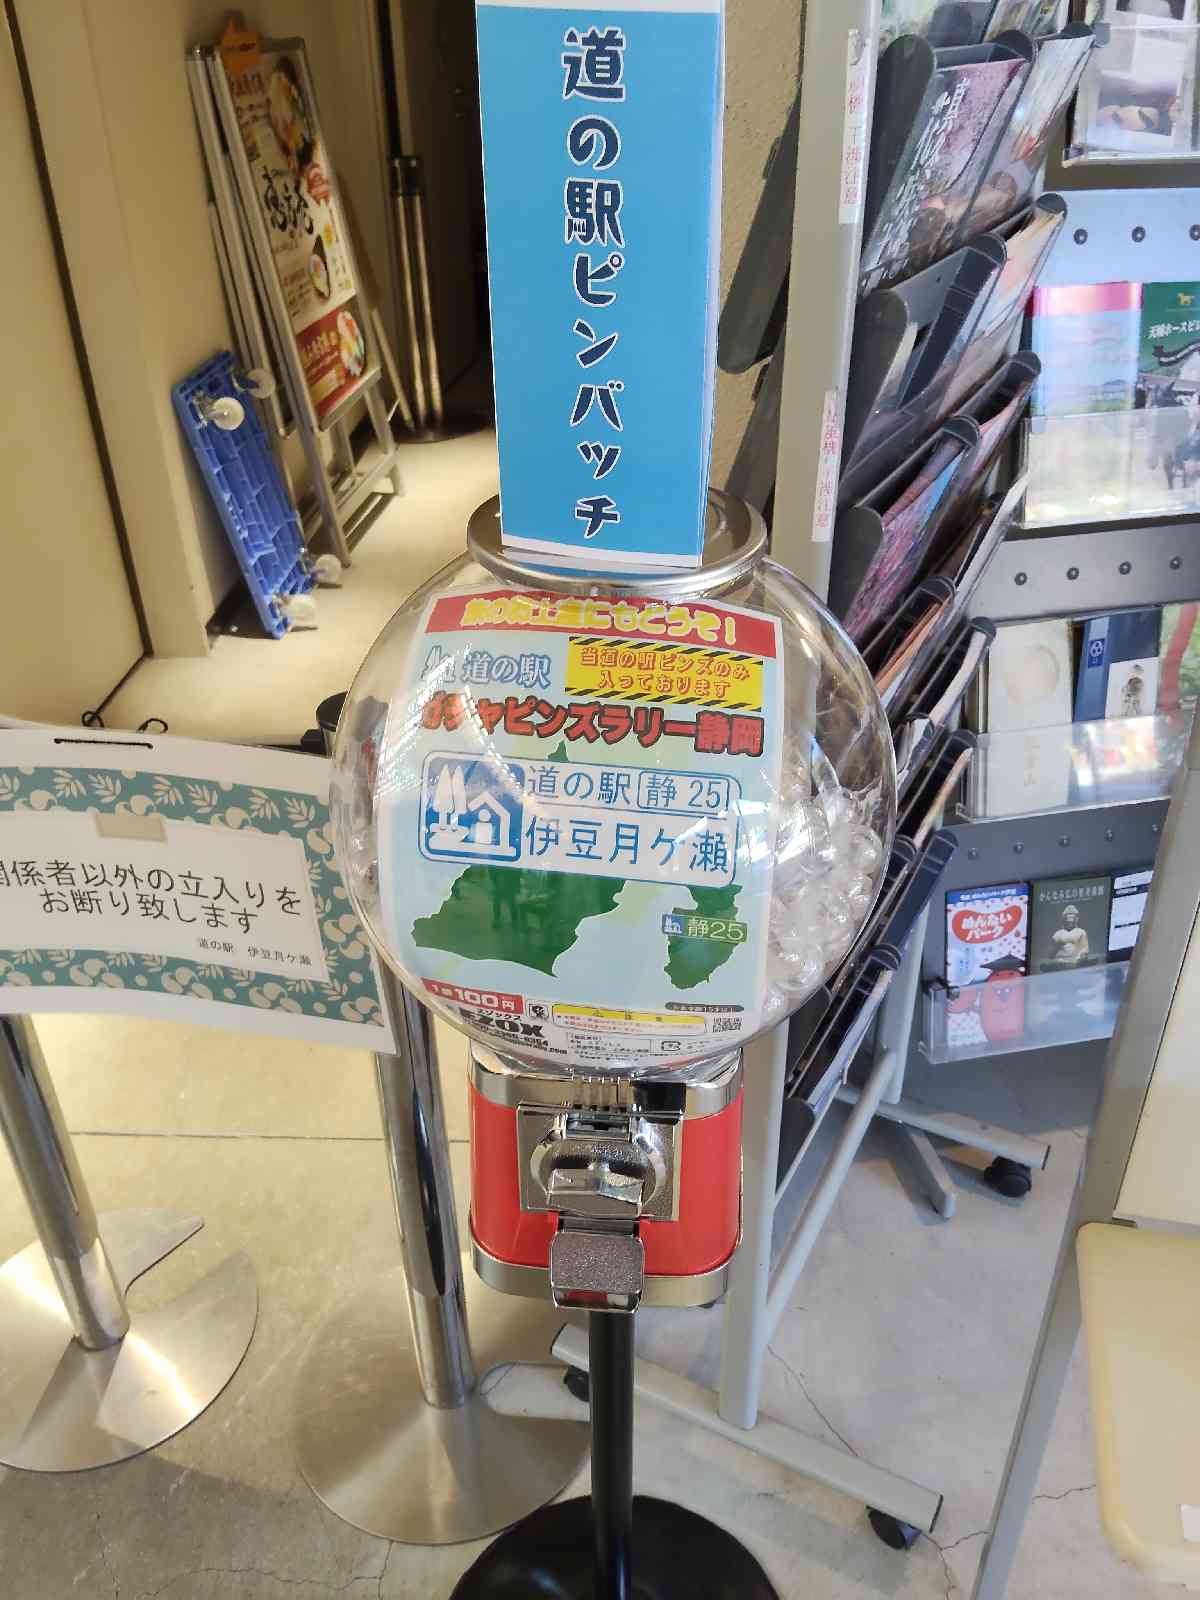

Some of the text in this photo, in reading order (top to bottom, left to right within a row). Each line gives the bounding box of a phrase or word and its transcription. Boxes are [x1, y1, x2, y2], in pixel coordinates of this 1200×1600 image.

[560, 27, 625, 538] 道の駅ピンバッチ
[462, 650, 551, 690] 道の駅
[581, 647, 750, 681] 当道の駅ピンズのみ
[599, 670, 731, 699] 入っております
[527, 765, 632, 806] 道の駅
[40, 887, 258, 934] お断り致します
[688, 918, 744, 941] 静25
